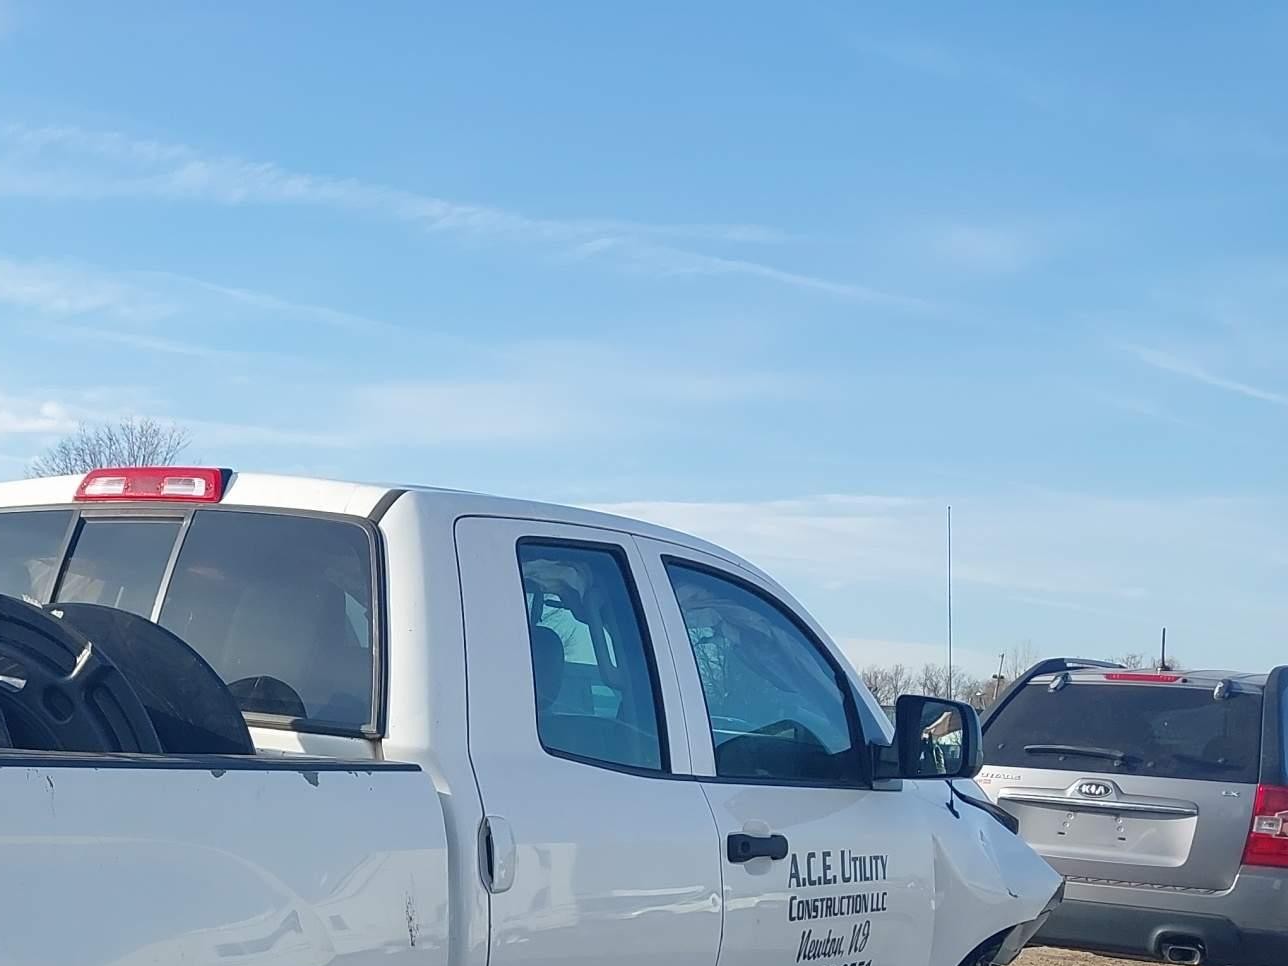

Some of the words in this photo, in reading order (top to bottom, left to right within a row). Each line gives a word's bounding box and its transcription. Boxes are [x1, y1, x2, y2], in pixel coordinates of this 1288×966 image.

[1081, 784, 1105, 796] KIA
[788, 850, 837, 888] A.C.E.
[870, 892, 887, 914] LLC
[796, 929, 844, 963] Newton,
[848, 920, 871, 956] NJ
